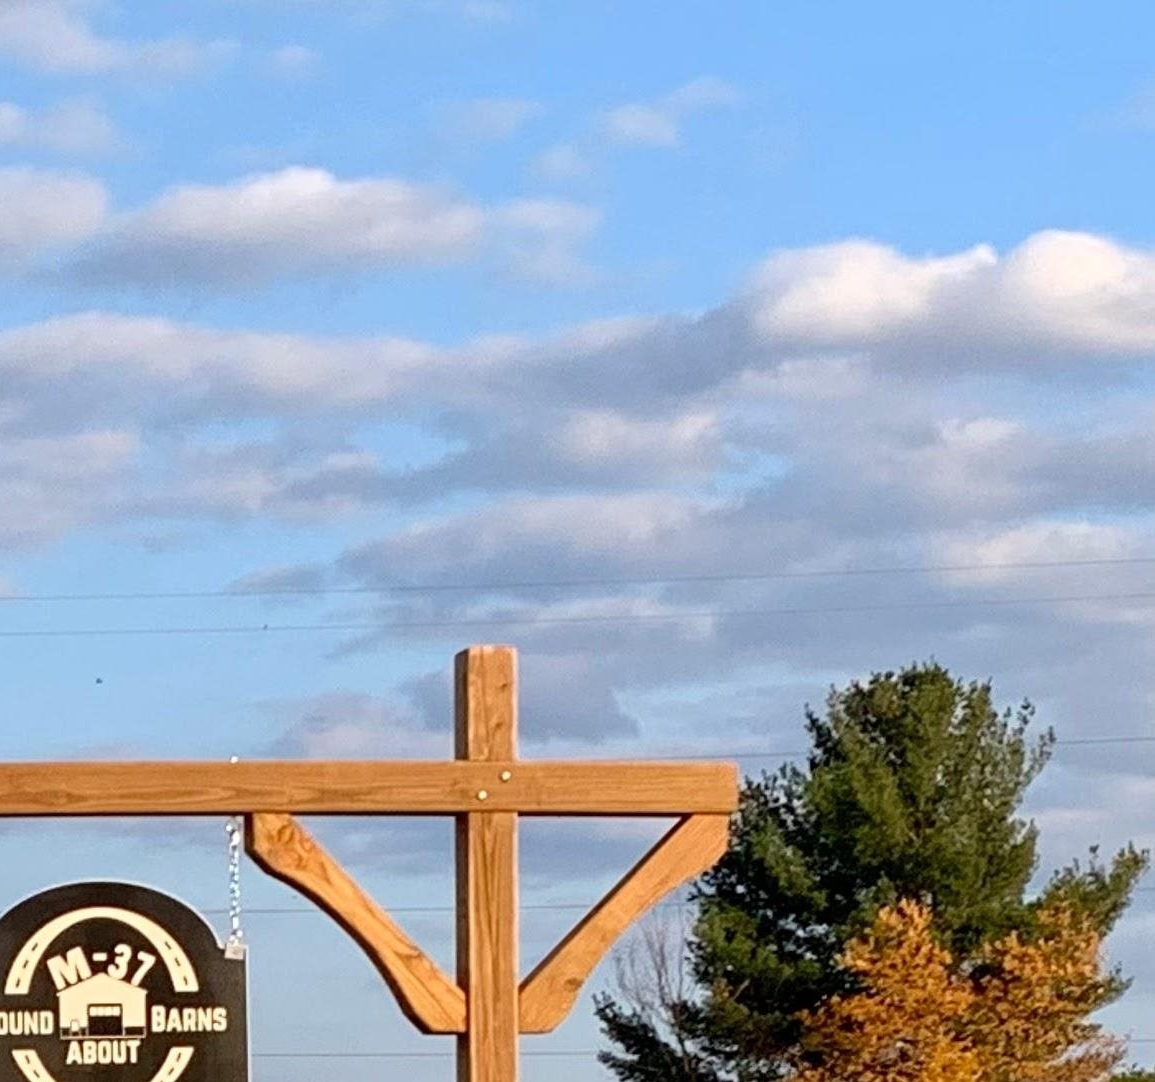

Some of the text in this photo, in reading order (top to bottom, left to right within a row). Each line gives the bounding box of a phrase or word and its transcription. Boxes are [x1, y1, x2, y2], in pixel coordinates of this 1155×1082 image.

[46, 943, 156, 991] M-37
[151, 1005, 228, 1033] BARNS
[65, 1040, 142, 1066] ABOUT
